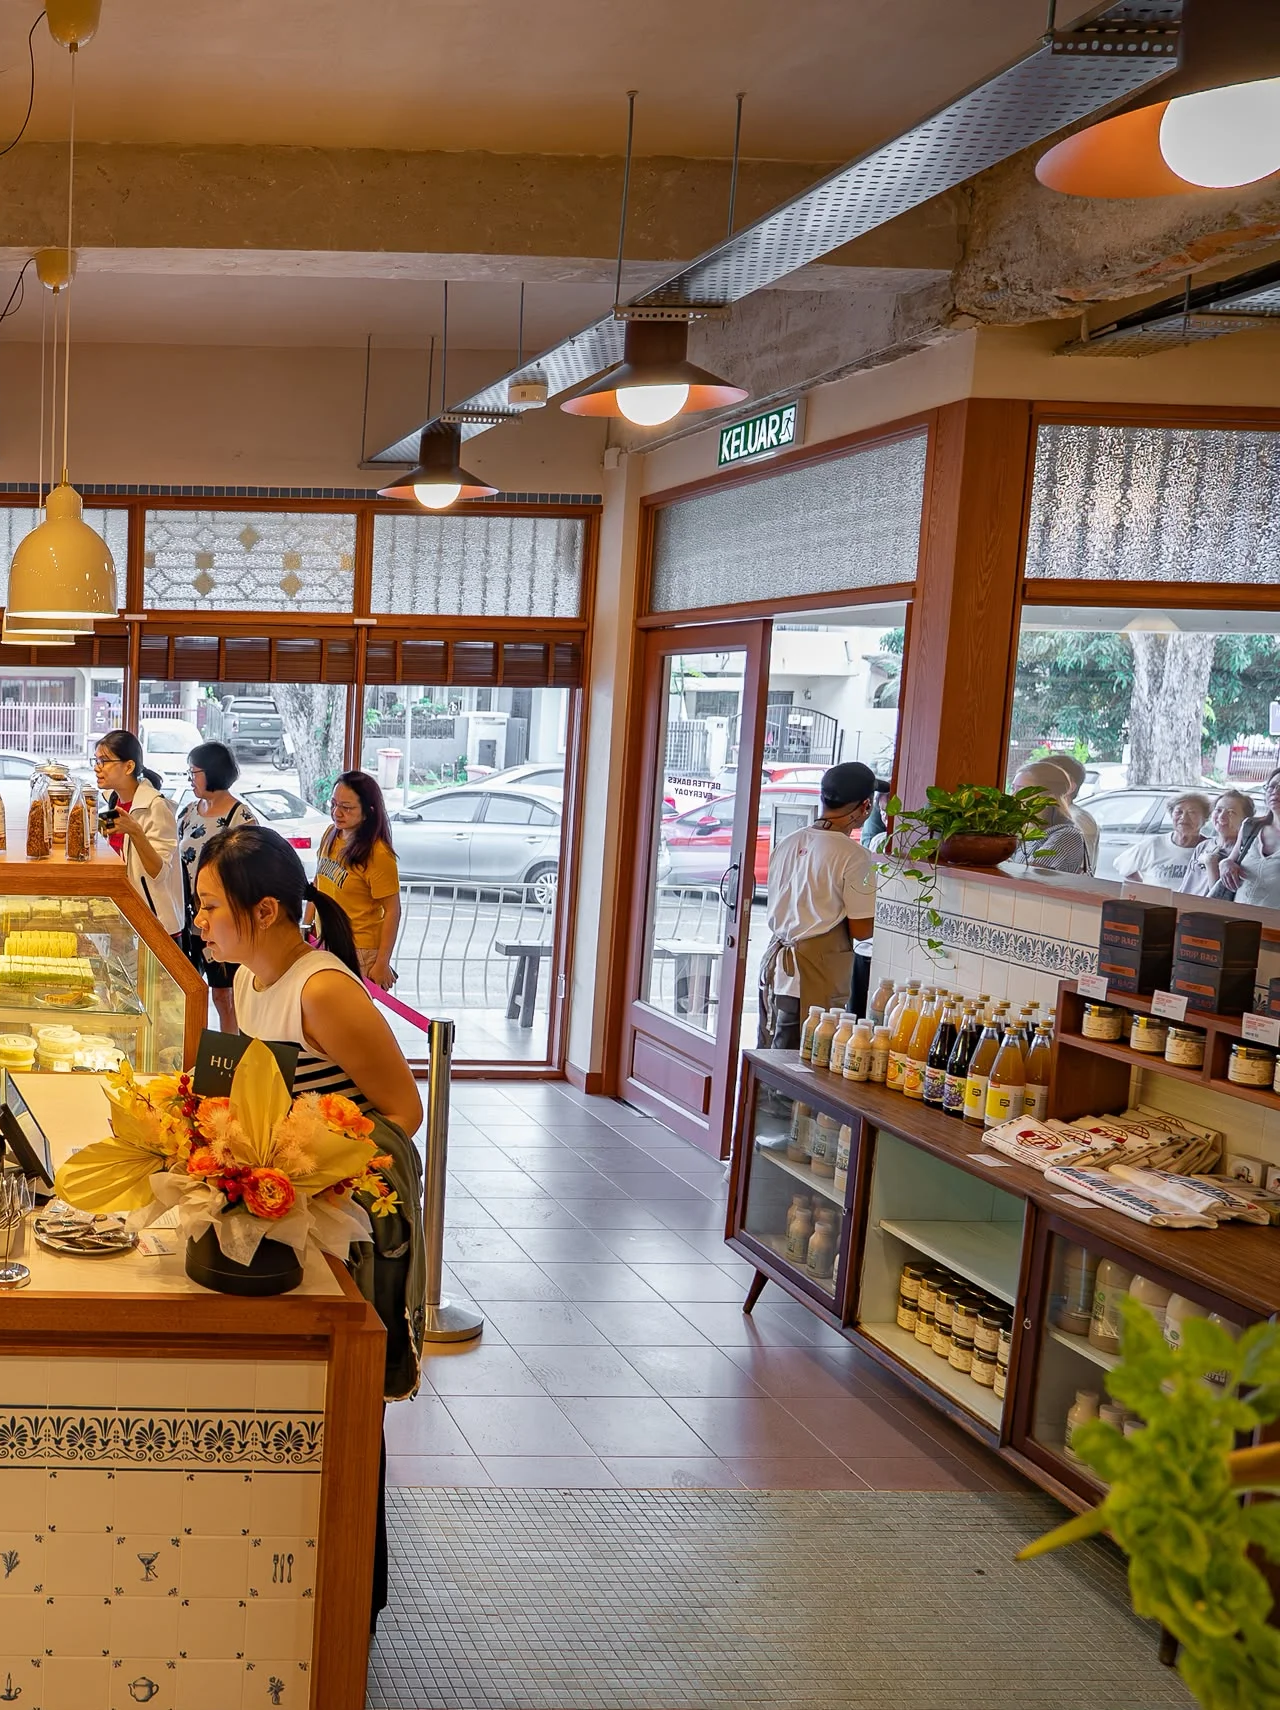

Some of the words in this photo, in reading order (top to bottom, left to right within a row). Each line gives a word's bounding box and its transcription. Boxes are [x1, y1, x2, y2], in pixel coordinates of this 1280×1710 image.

[721, 414, 780, 462] KELUAR
[1103, 933, 1120, 943] DRIP
[1121, 935, 1137, 947] BAG
[1179, 948, 1197, 960] DRIP
[1200, 952, 1218, 963] BAG
[210, 1055, 234, 1070] HU
